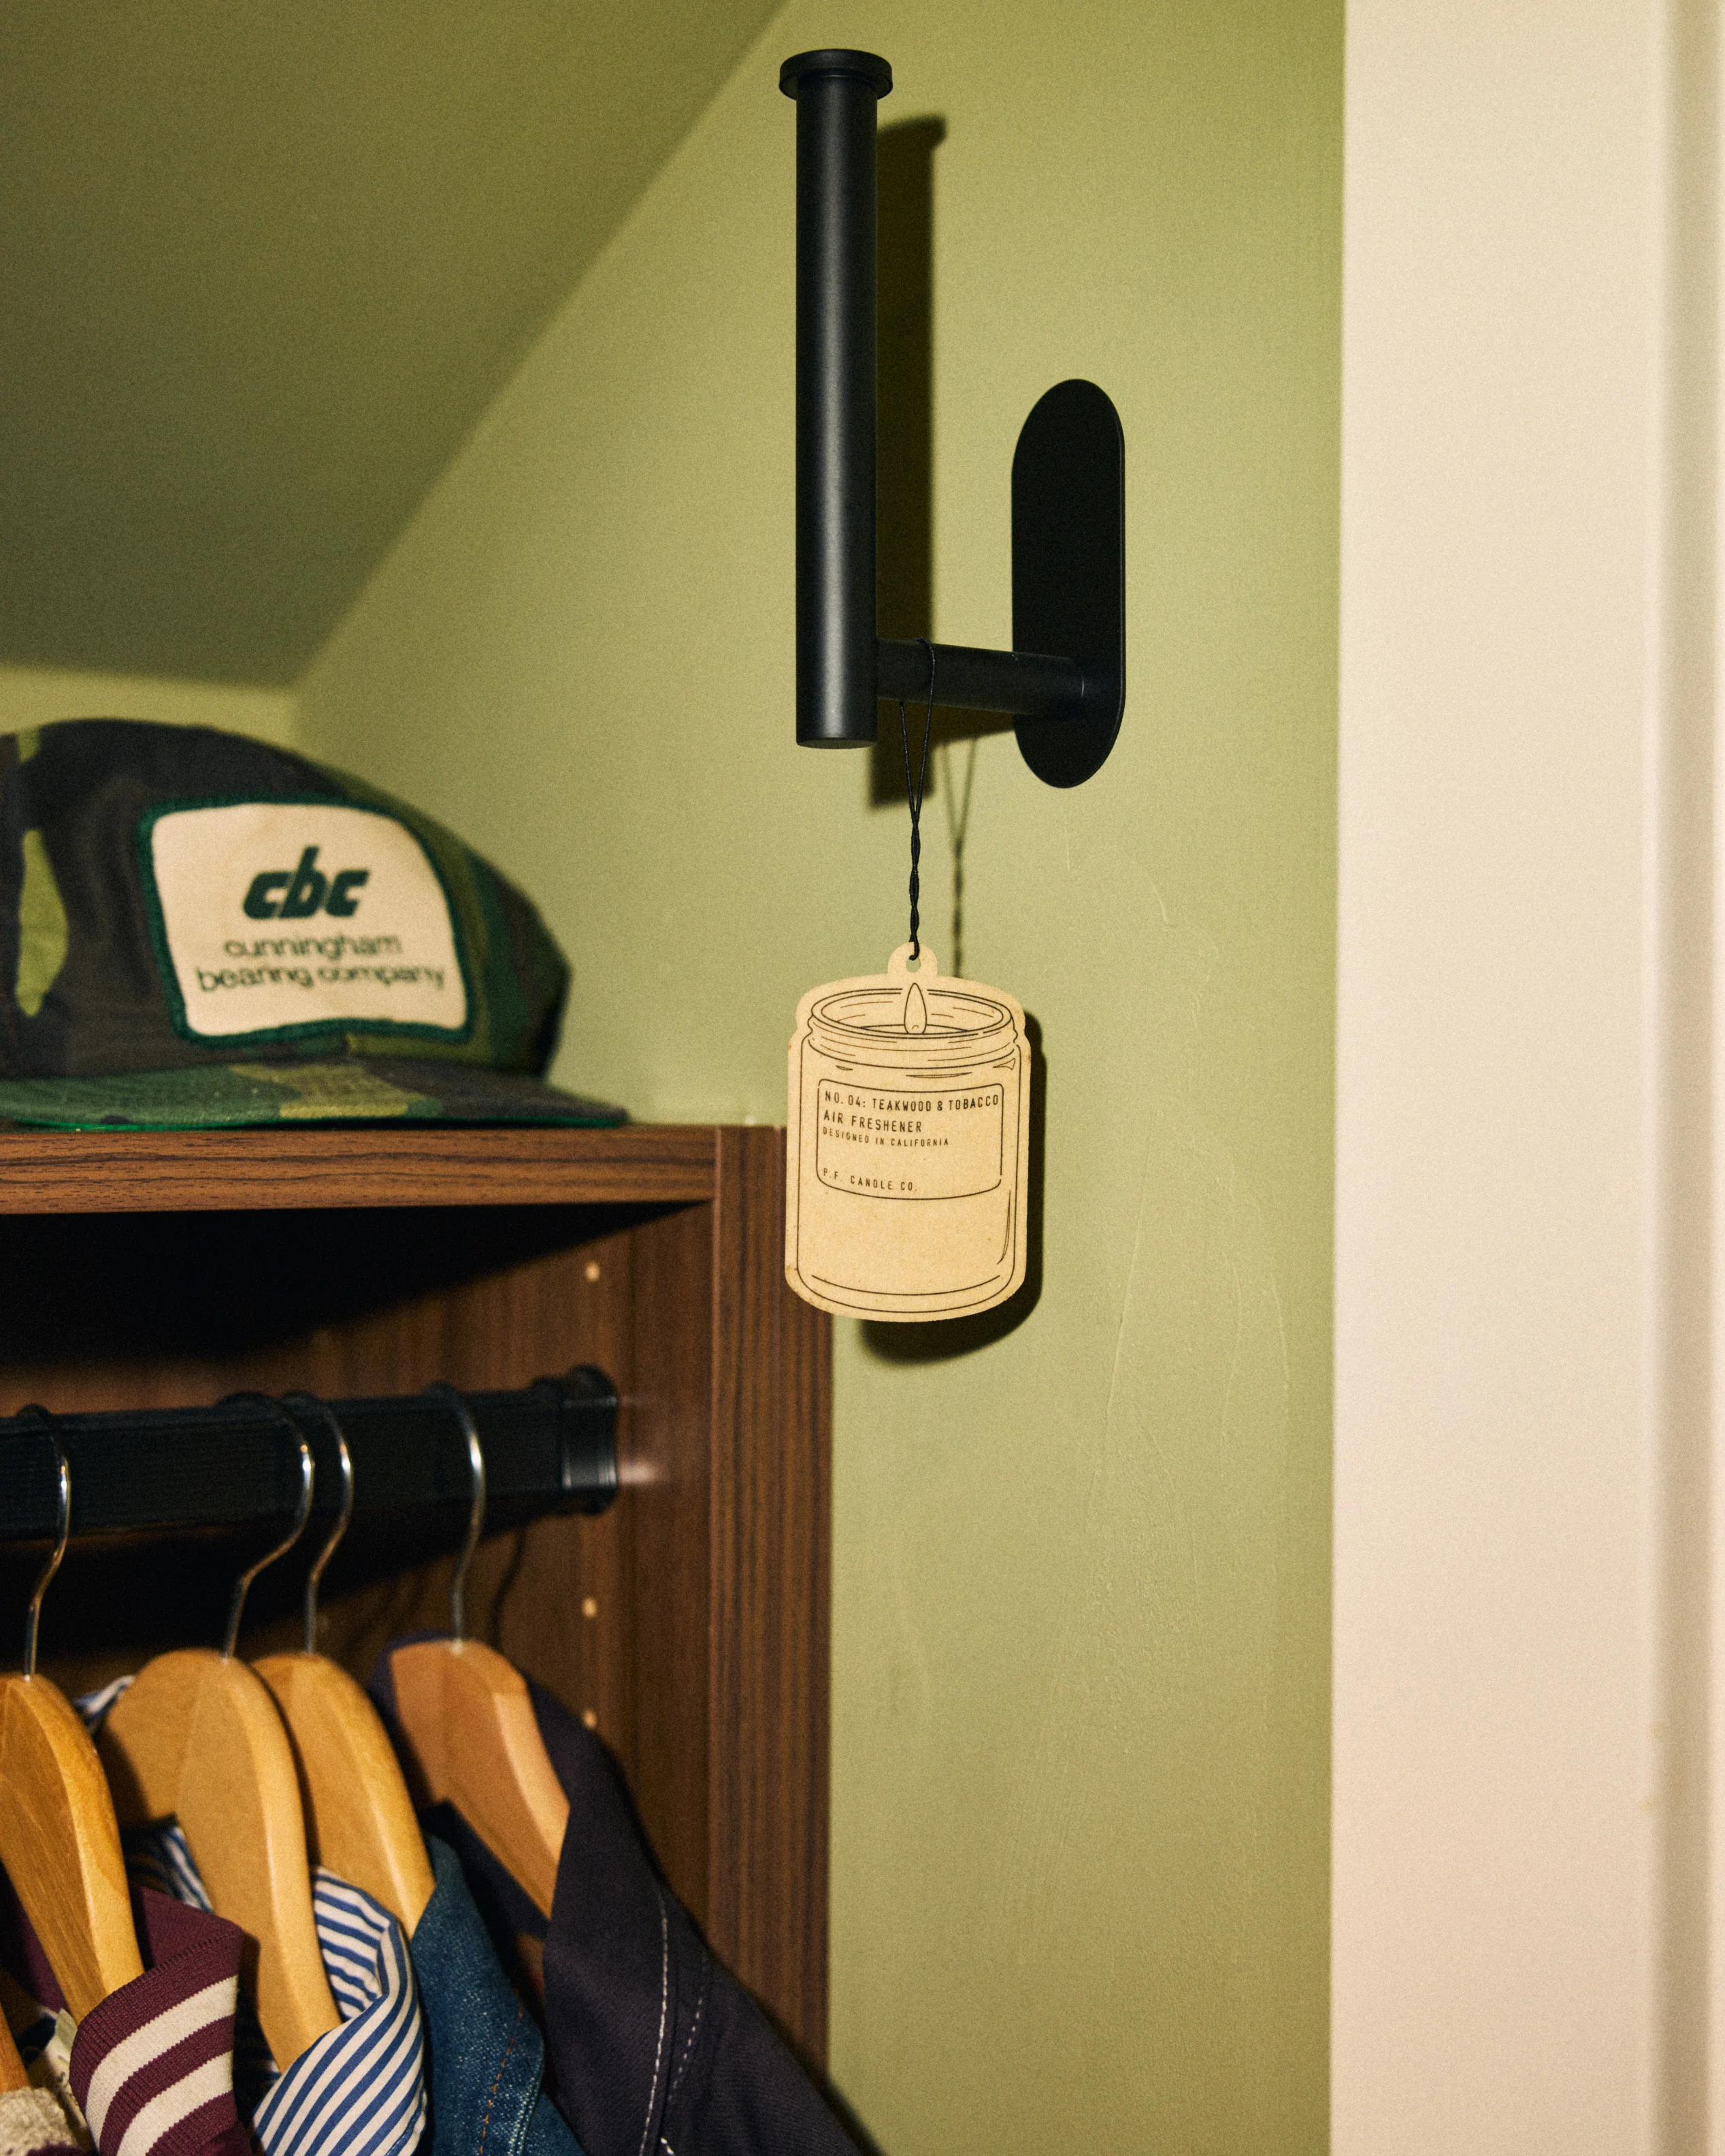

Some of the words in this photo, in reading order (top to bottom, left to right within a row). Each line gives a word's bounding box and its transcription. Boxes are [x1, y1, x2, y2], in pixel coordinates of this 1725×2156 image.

[243, 845, 370, 919] cbc
[224, 932, 403, 961] cunningham
[195, 964, 314, 992] bearing
[318, 964, 444, 990] company
[825, 1090, 844, 1105] NO.
[848, 1094, 866, 1108] 04:
[872, 1098, 932, 1111] TEAKWOOD
[937, 1100, 943, 1111] &
[949, 1094, 998, 1111] TOBACCO
[823, 1109, 843, 1124] AIR
[851, 1115, 921, 1132] FRESHENER
[823, 1126, 869, 1143] DESIGNED
[876, 1137, 885, 1145] IN
[891, 1138, 949, 1147] CALIFORNIA
[851, 1175, 892, 1190] CANDLE
